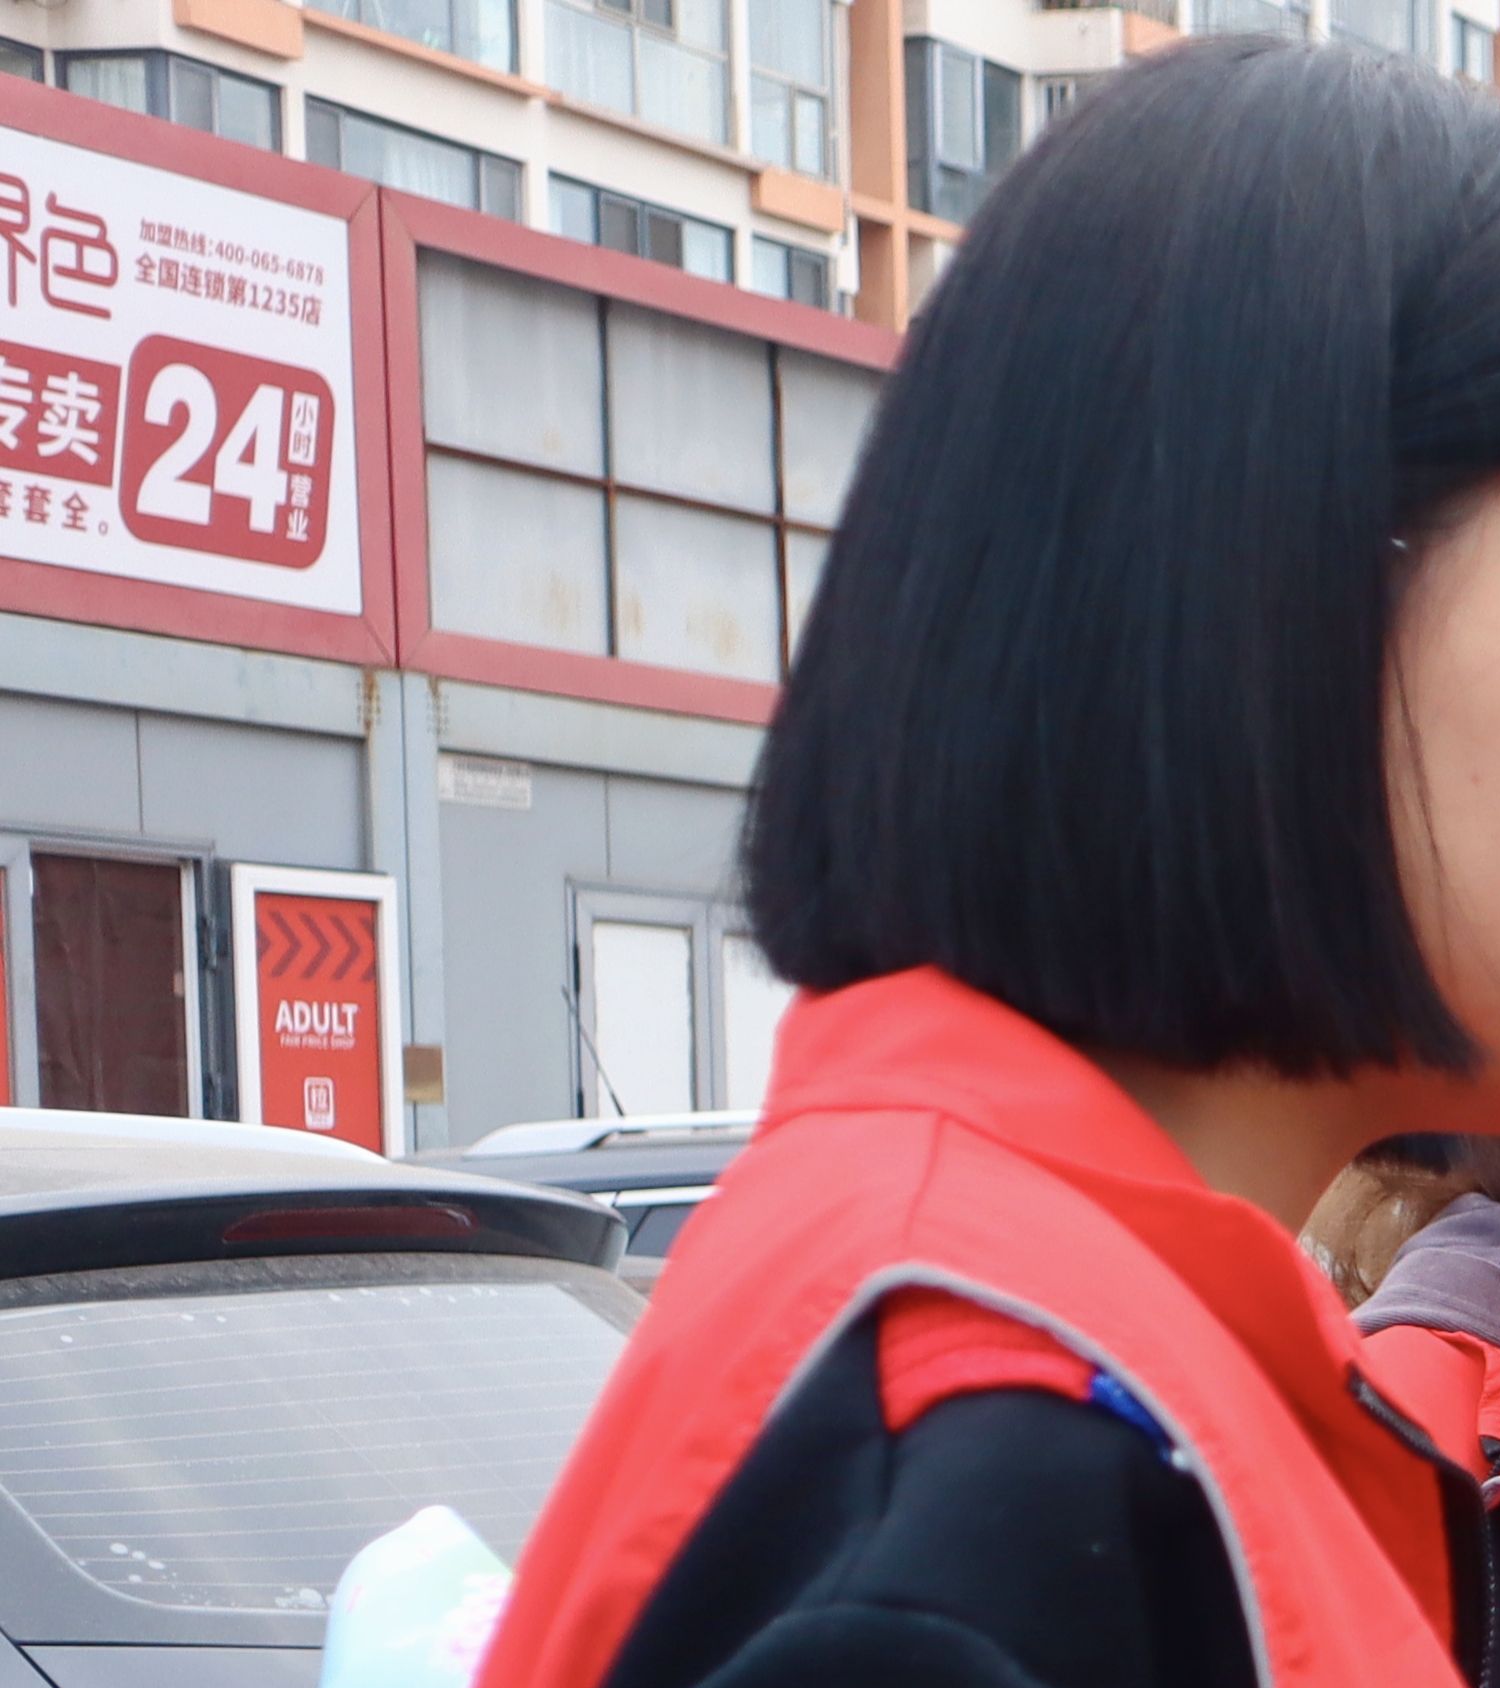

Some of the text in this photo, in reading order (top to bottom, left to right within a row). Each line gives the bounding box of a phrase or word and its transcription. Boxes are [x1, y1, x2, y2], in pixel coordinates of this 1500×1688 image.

[135, 253, 322, 326] 全国连锁第1235店
[136, 362, 289, 534] 24
[275, 999, 360, 1036] ADULT
